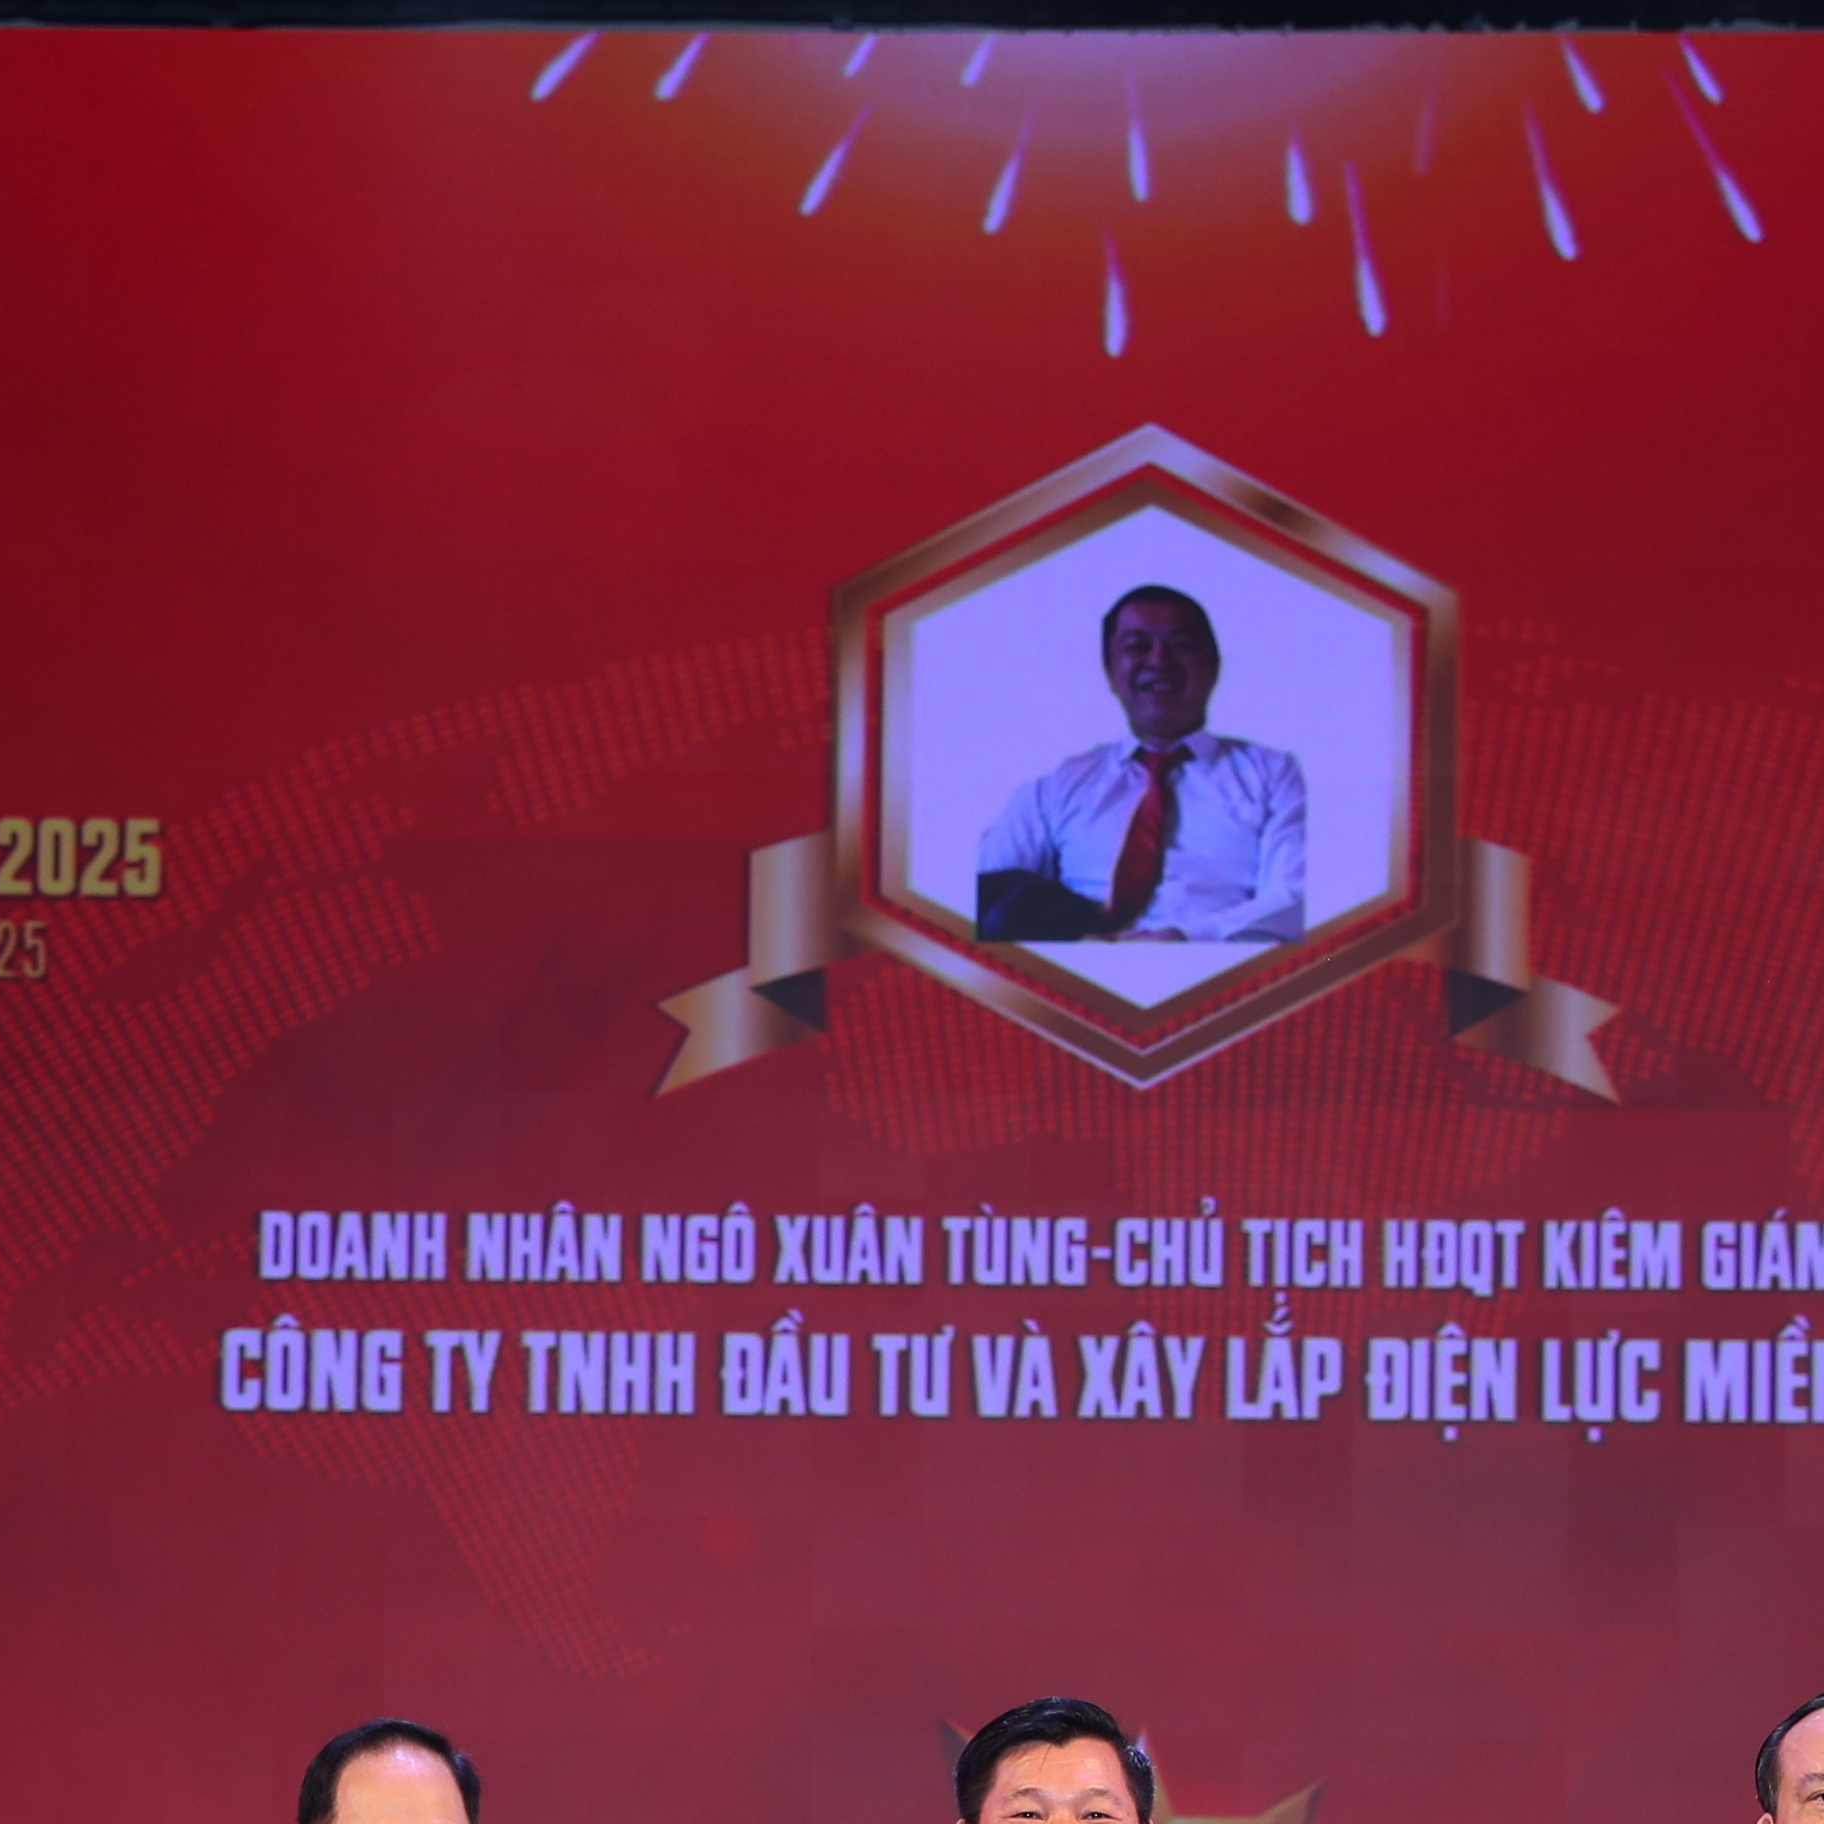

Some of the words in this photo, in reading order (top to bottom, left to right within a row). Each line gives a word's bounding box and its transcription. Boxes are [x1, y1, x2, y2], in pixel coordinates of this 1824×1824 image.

[258, 1210, 447, 1282] DOANH
[466, 1201, 622, 1284] NHÂN
[640, 1202, 755, 1285] NGÔ
[774, 1203, 922, 1286] XUÂN
[940, 1196, 1224, 1288] TÙNG-CHỦ
[1240, 1217, 1364, 1304] TỊCH
[1381, 1219, 1525, 1297] HĐQT
[1542, 1207, 1681, 1290] KIÊM
[220, 1312, 404, 1414] CÔNG
[424, 1328, 502, 1414] TY
[520, 1328, 698, 1416] TNHH
[718, 1305, 850, 1418] ĐẦU
[870, 1323, 956, 1419] TƯ
[970, 1318, 1058, 1420] VÀ
[1076, 1319, 1205, 1421] XÂY
[1224, 1303, 1344, 1422] LẮP
[1363, 1321, 1518, 1442] ĐIỆN
[1540, 1328, 1662, 1443] LỰC
